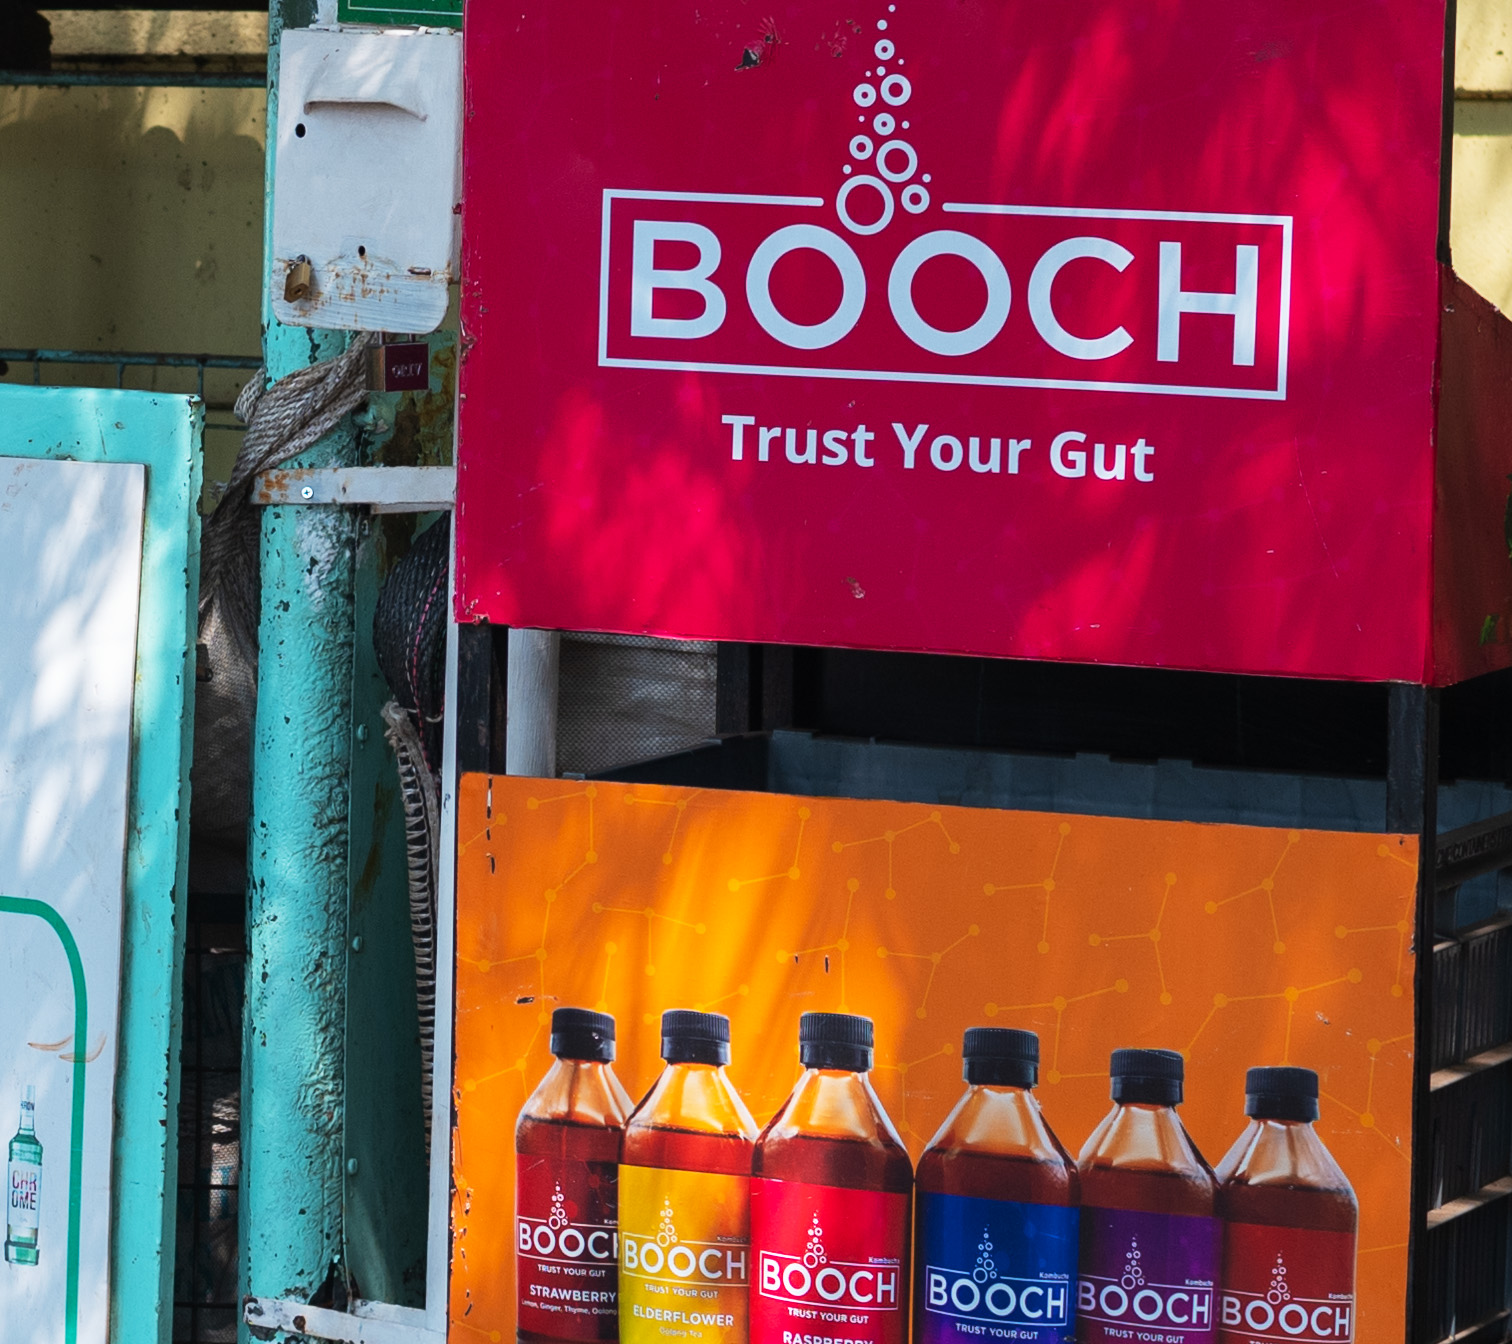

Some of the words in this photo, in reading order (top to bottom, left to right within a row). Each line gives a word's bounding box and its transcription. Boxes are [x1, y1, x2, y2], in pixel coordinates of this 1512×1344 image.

[630, 220, 1258, 366] BOOCH
[722, 415, 874, 467] Trust
[891, 423, 1031, 473] Your
[1050, 431, 1154, 481] Gut
[530, 1284, 616, 1302] STRAWBERRY
[763, 1258, 895, 1302] BOOCH
[929, 1273, 1064, 1318] BOOCH
[633, 1304, 733, 1326] ELDERFLOWER
